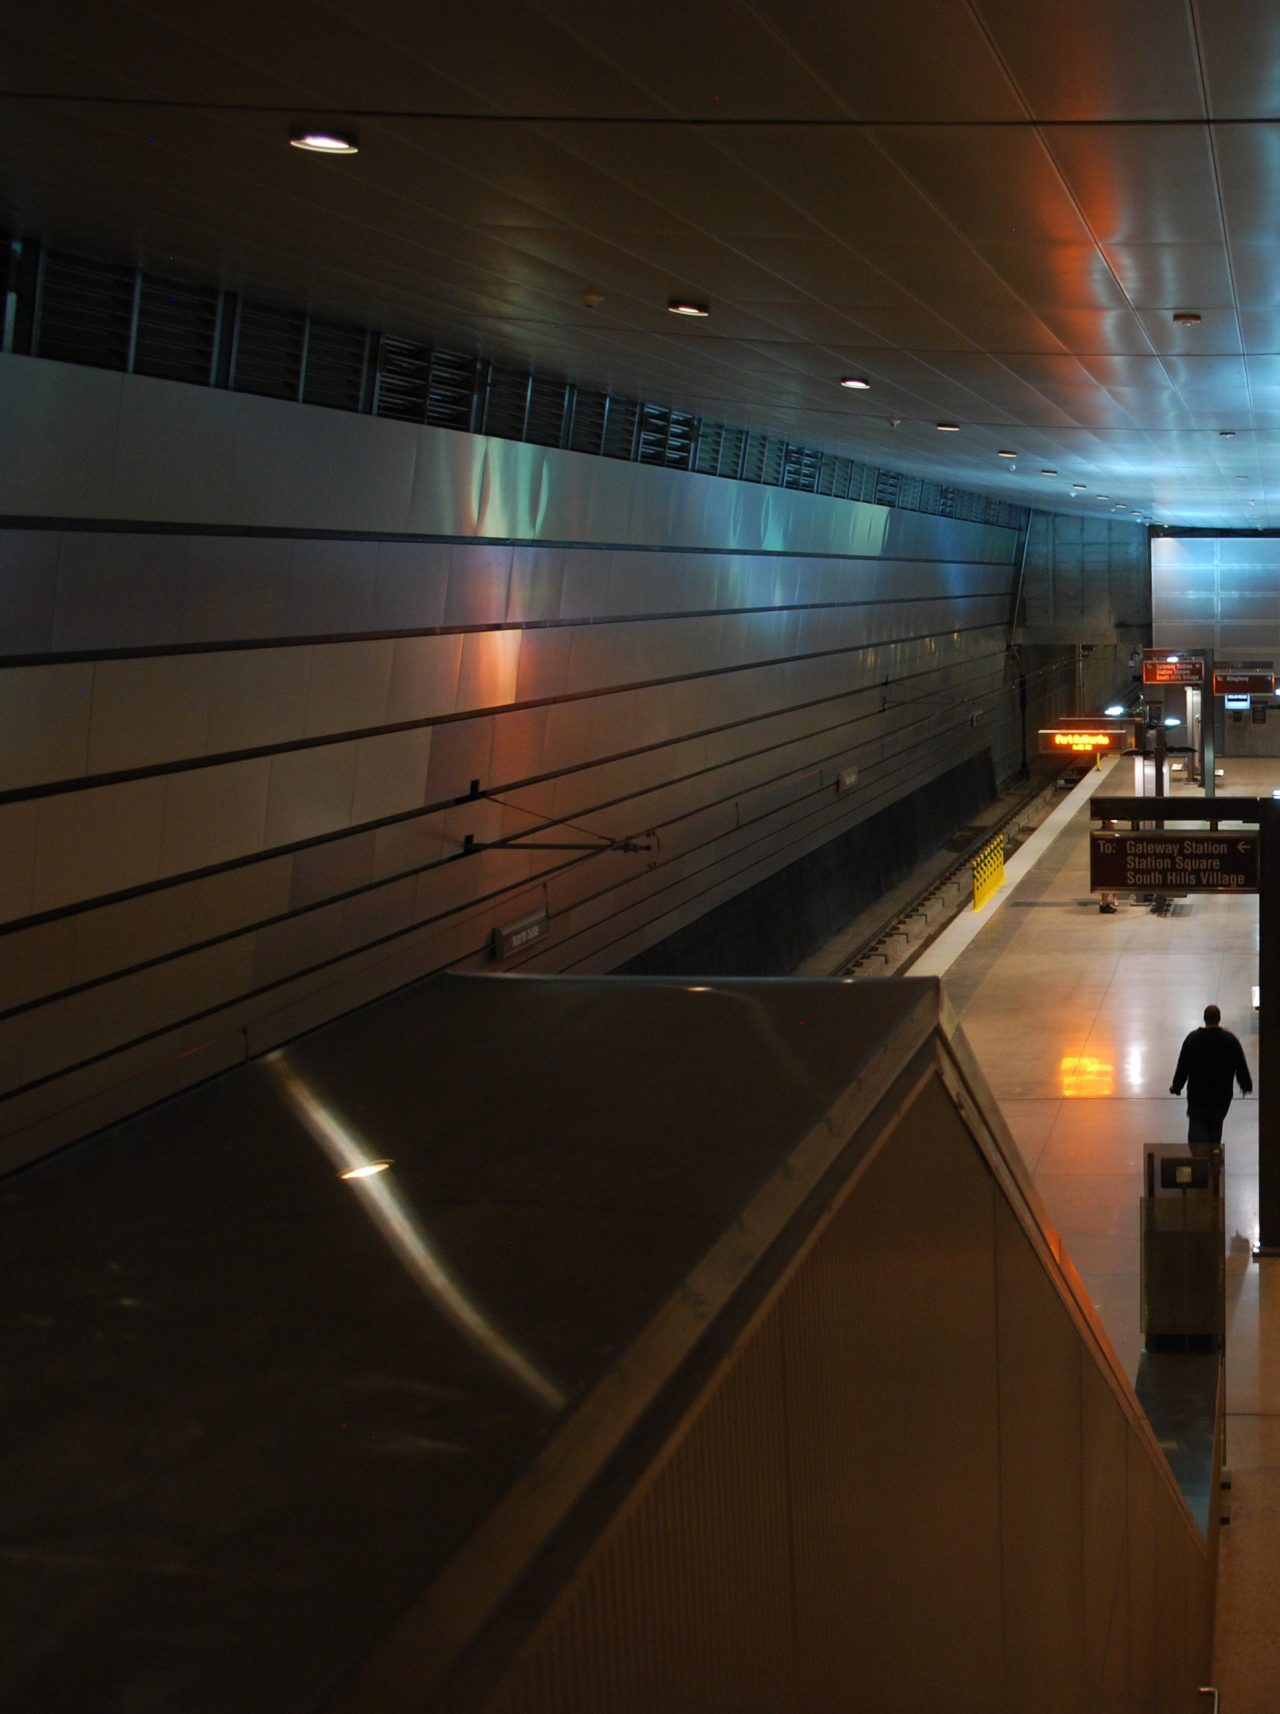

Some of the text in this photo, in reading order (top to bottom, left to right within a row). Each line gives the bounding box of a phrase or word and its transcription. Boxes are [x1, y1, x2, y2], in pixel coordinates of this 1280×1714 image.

[1098, 840, 1228, 856] To: Gateway Station
[1126, 856, 1220, 871] Station Square
[1127, 871, 1245, 887] South Hills Village
